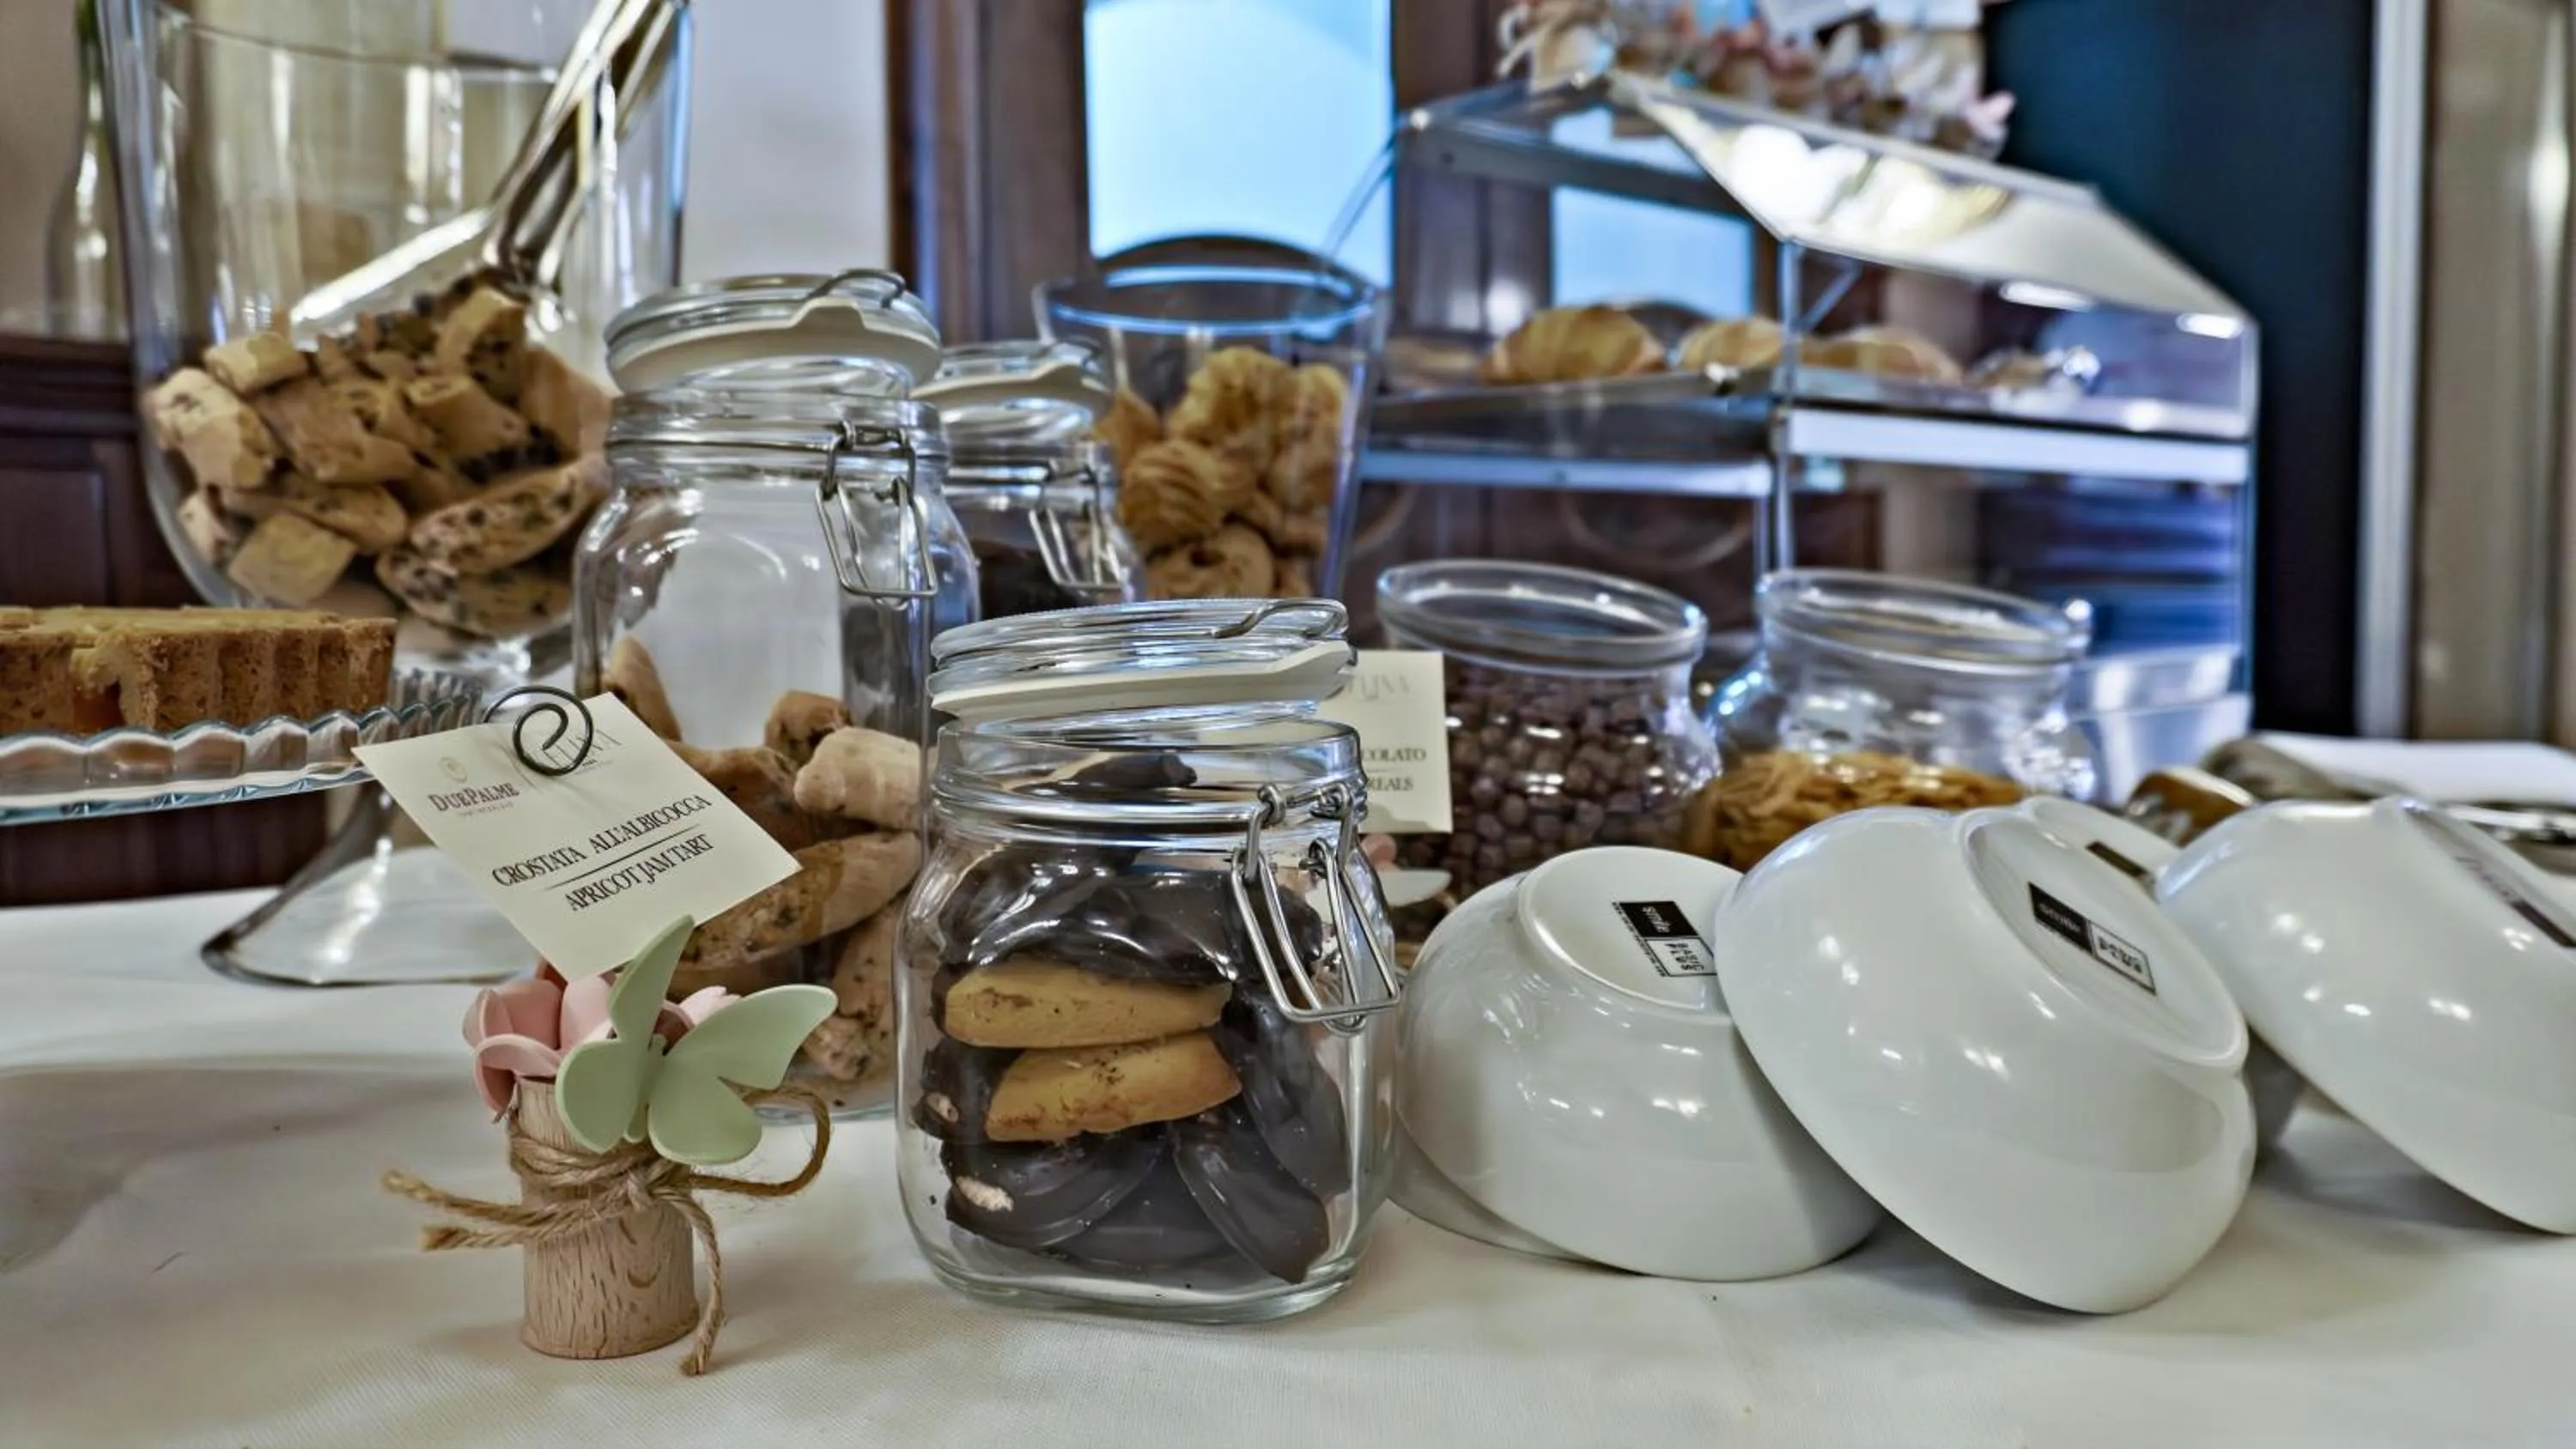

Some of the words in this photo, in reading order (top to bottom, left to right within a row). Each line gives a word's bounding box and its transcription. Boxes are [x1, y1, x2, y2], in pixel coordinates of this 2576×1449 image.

[1362, 747, 1427, 762] COLATO
[1367, 776, 1415, 791] REALS
[491, 846, 588, 887] CROSTATA
[587, 793, 713, 854] ALL'ALBICOCCA
[564, 865, 642, 912] APRICOT
[636, 853, 676, 885] JAM
[672, 833, 714, 862] TART
